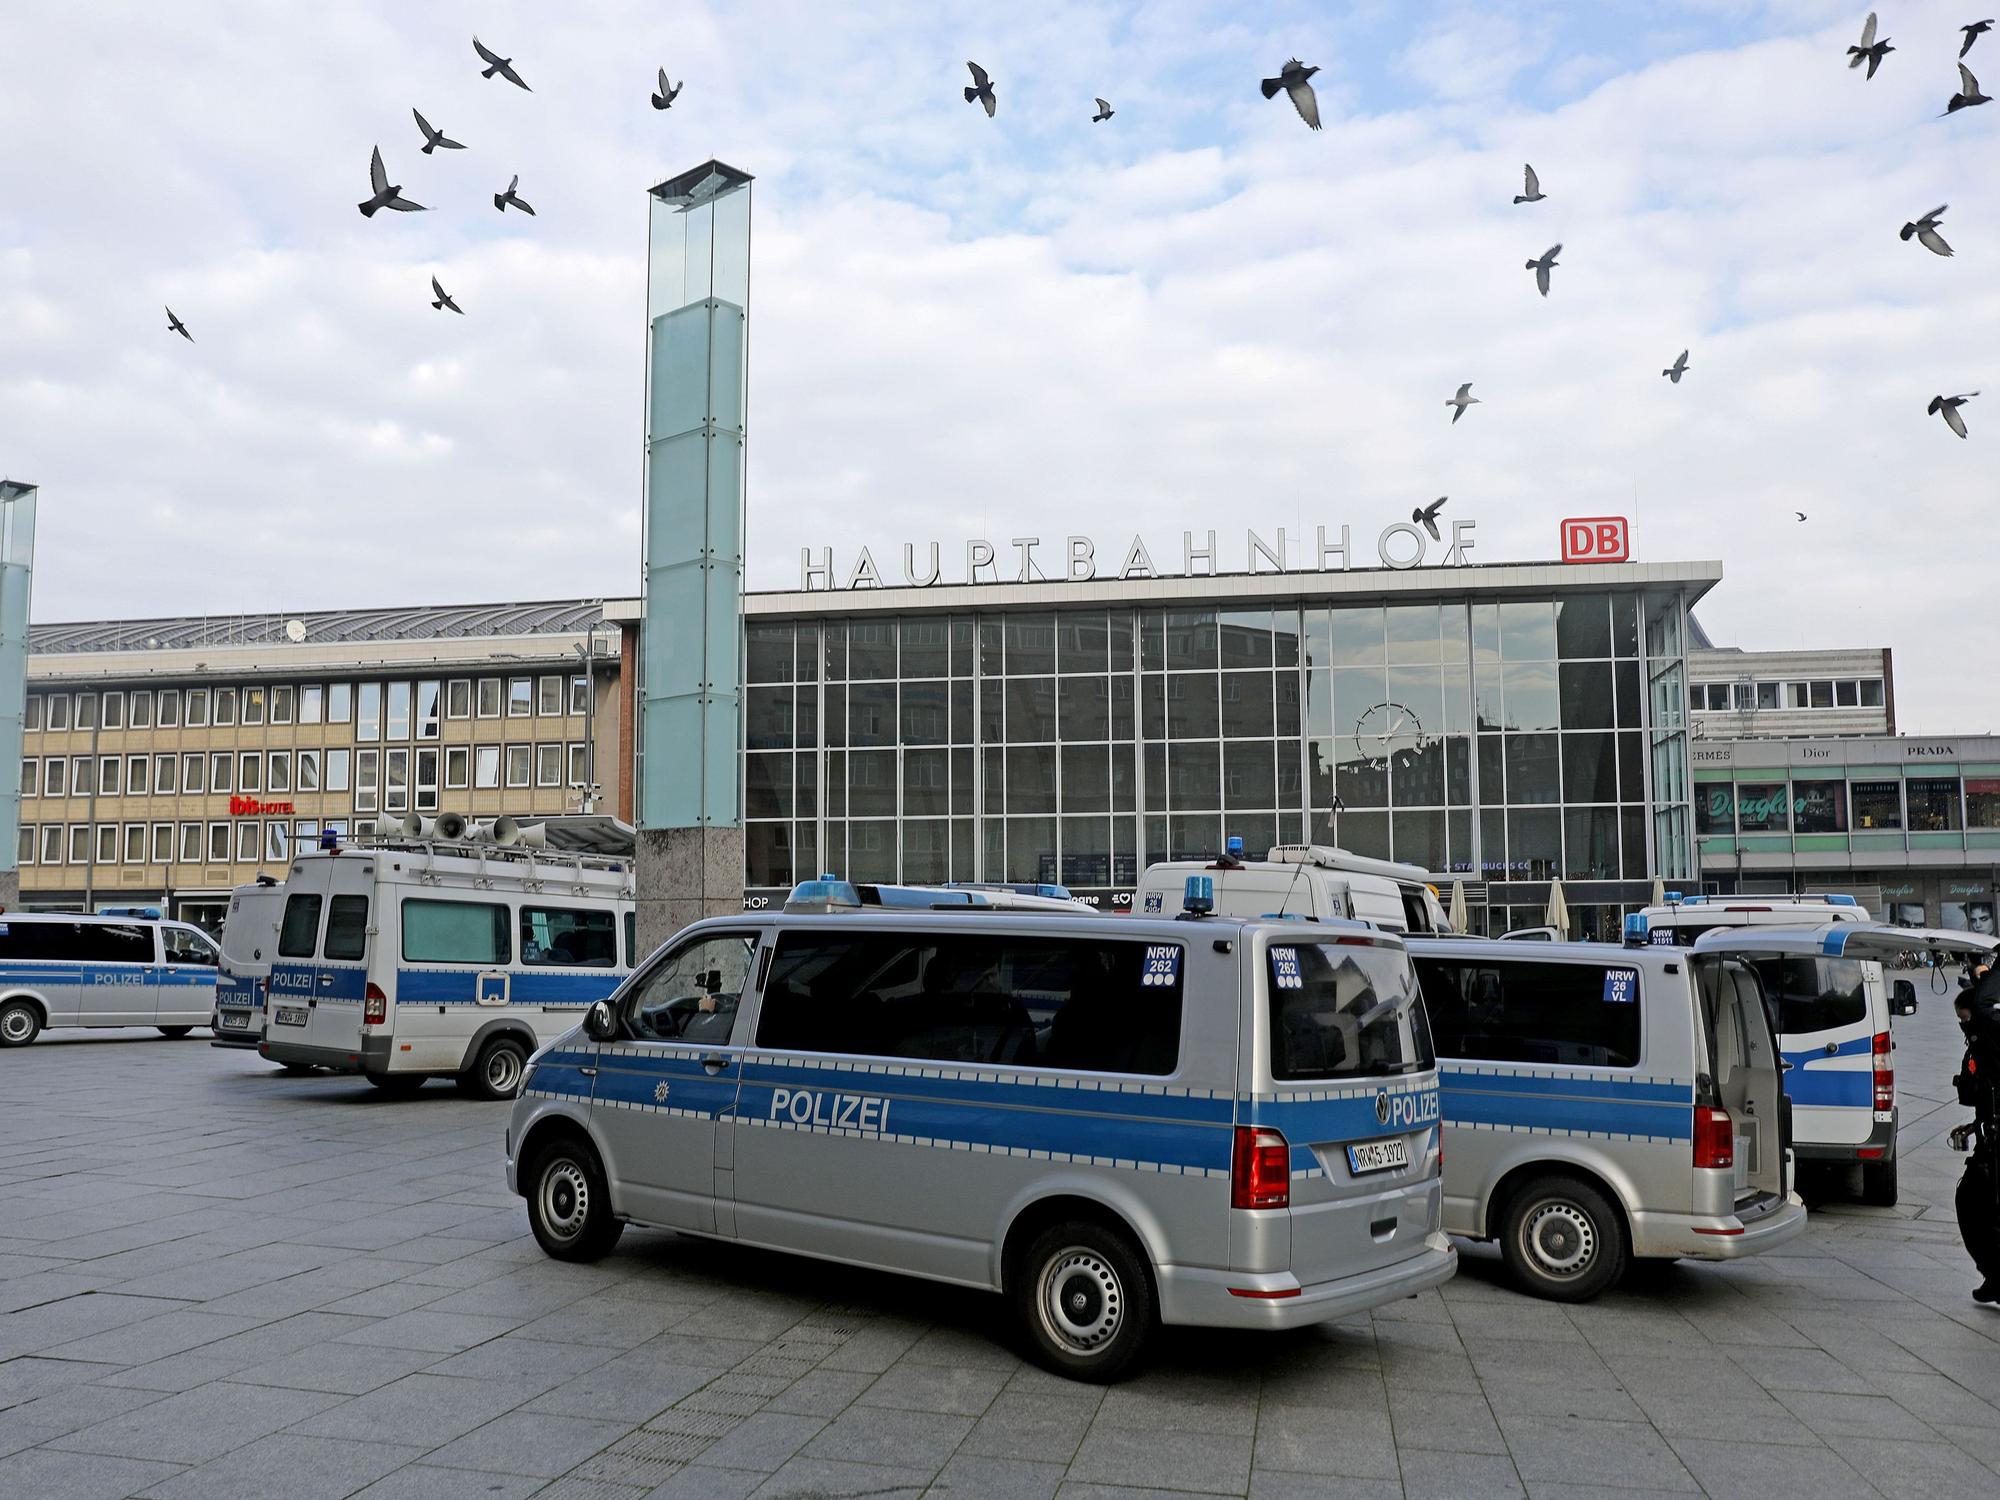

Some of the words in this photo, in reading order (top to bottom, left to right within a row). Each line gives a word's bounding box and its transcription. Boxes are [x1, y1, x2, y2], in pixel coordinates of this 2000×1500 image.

[1570, 523, 1622, 556] DB
[800, 519, 1477, 592] HAUPTBAHNHOF
[1802, 748, 1831, 758] Dior
[1907, 745, 1954, 756] PRADA
[229, 794, 260, 815] ibis
[1454, 861, 1516, 871] STABUCKS
[1517, 861, 1557, 870] COE
[1070, 895, 1099, 905] ogne
[1652, 929, 1673, 938] NRW
[1147, 947, 1179, 960] NRW
[1271, 948, 1296, 961] NRW
[1150, 960, 1172, 972] 262
[1278, 961, 1297, 974] 262
[94, 973, 145, 985] POLIZEI
[273, 973, 312, 989] POLIZEI
[1606, 970, 1635, 982] NRW
[1612, 981, 1627, 992] 26
[219, 991, 251, 1005] POLIZEI
[1611, 991, 1627, 1002] VL
[770, 1088, 891, 1132] POLIZEI
[1393, 1092, 1439, 1127] POLIZEI
[1375, 1142, 1404, 1164] 5-1927
